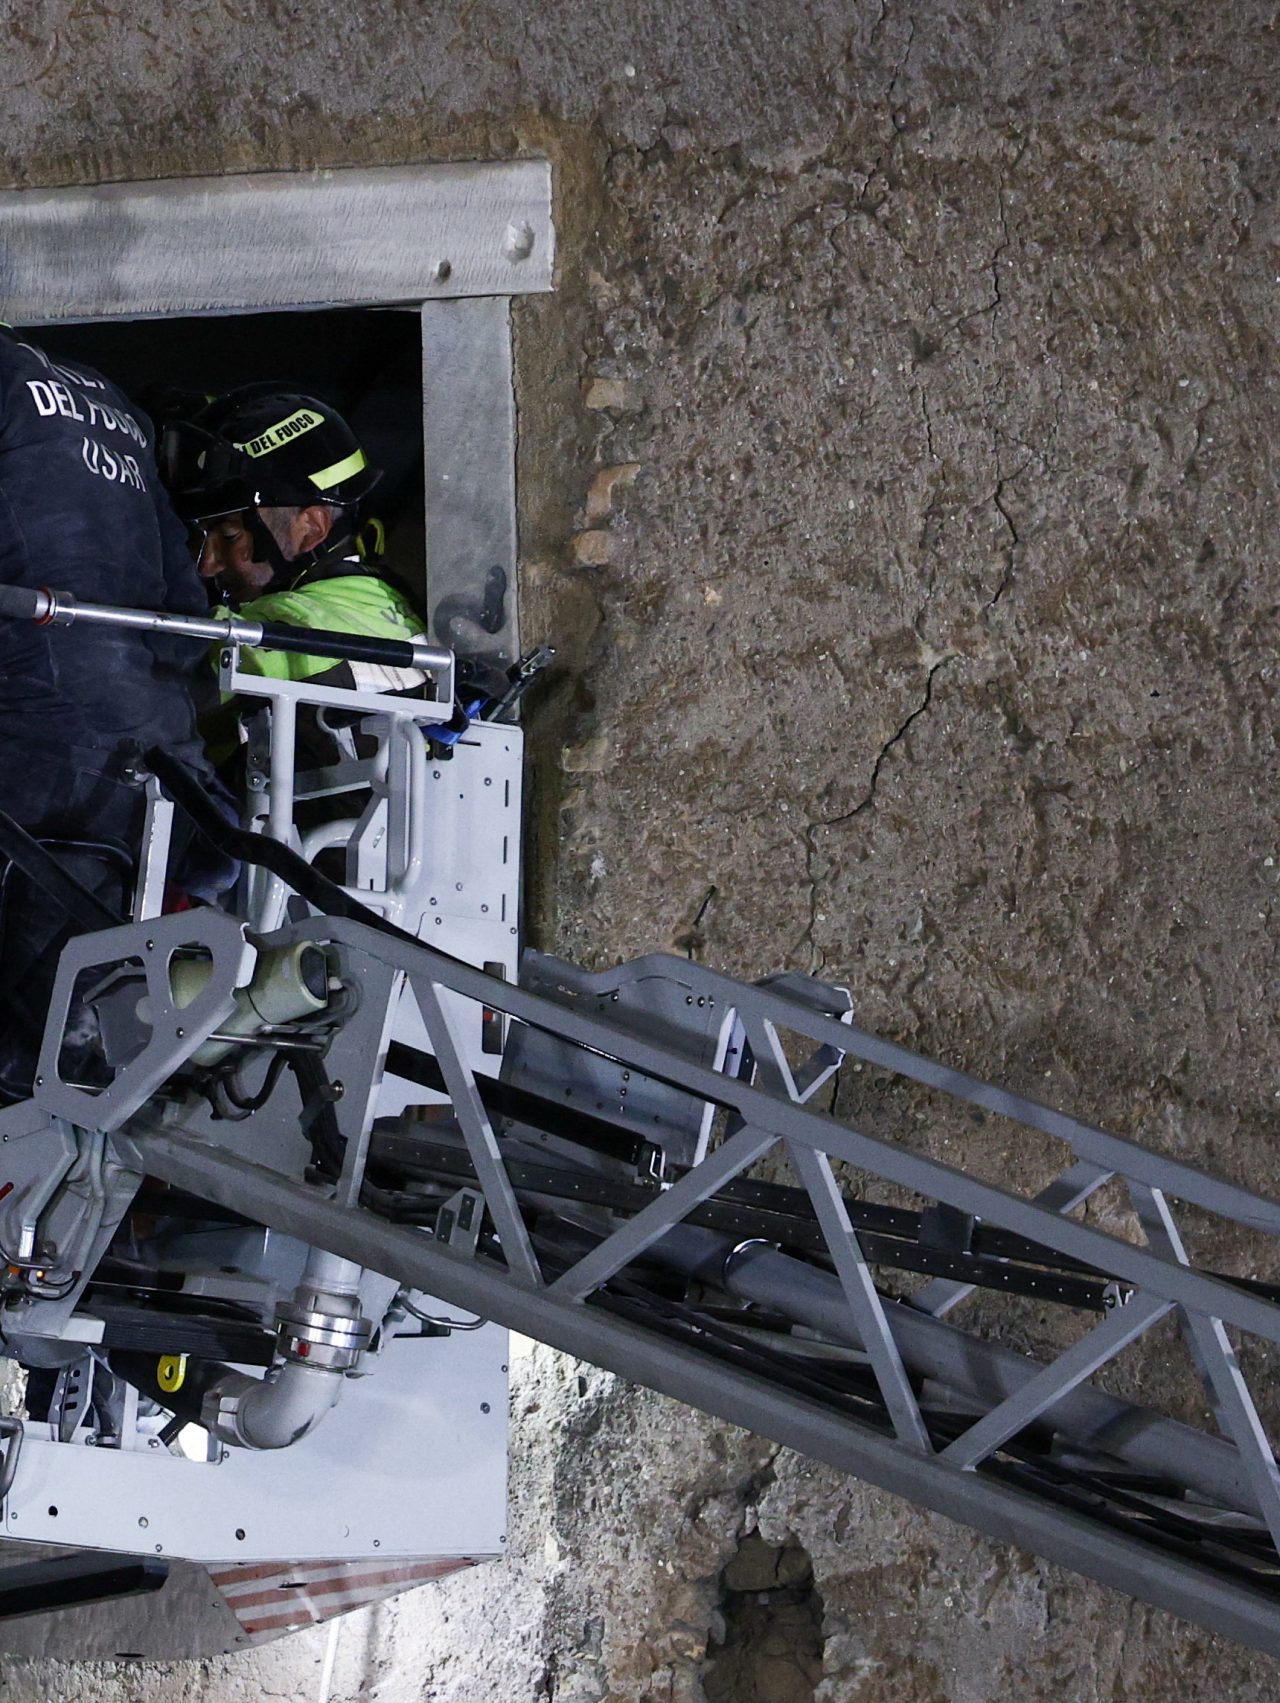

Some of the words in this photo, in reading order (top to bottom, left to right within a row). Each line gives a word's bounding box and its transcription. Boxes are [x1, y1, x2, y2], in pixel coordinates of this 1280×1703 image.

[26, 380, 85, 422] DEL
[249, 434, 277, 455] DEL
[274, 413, 315, 442] FUOCO
[82, 436, 147, 493] USAR
